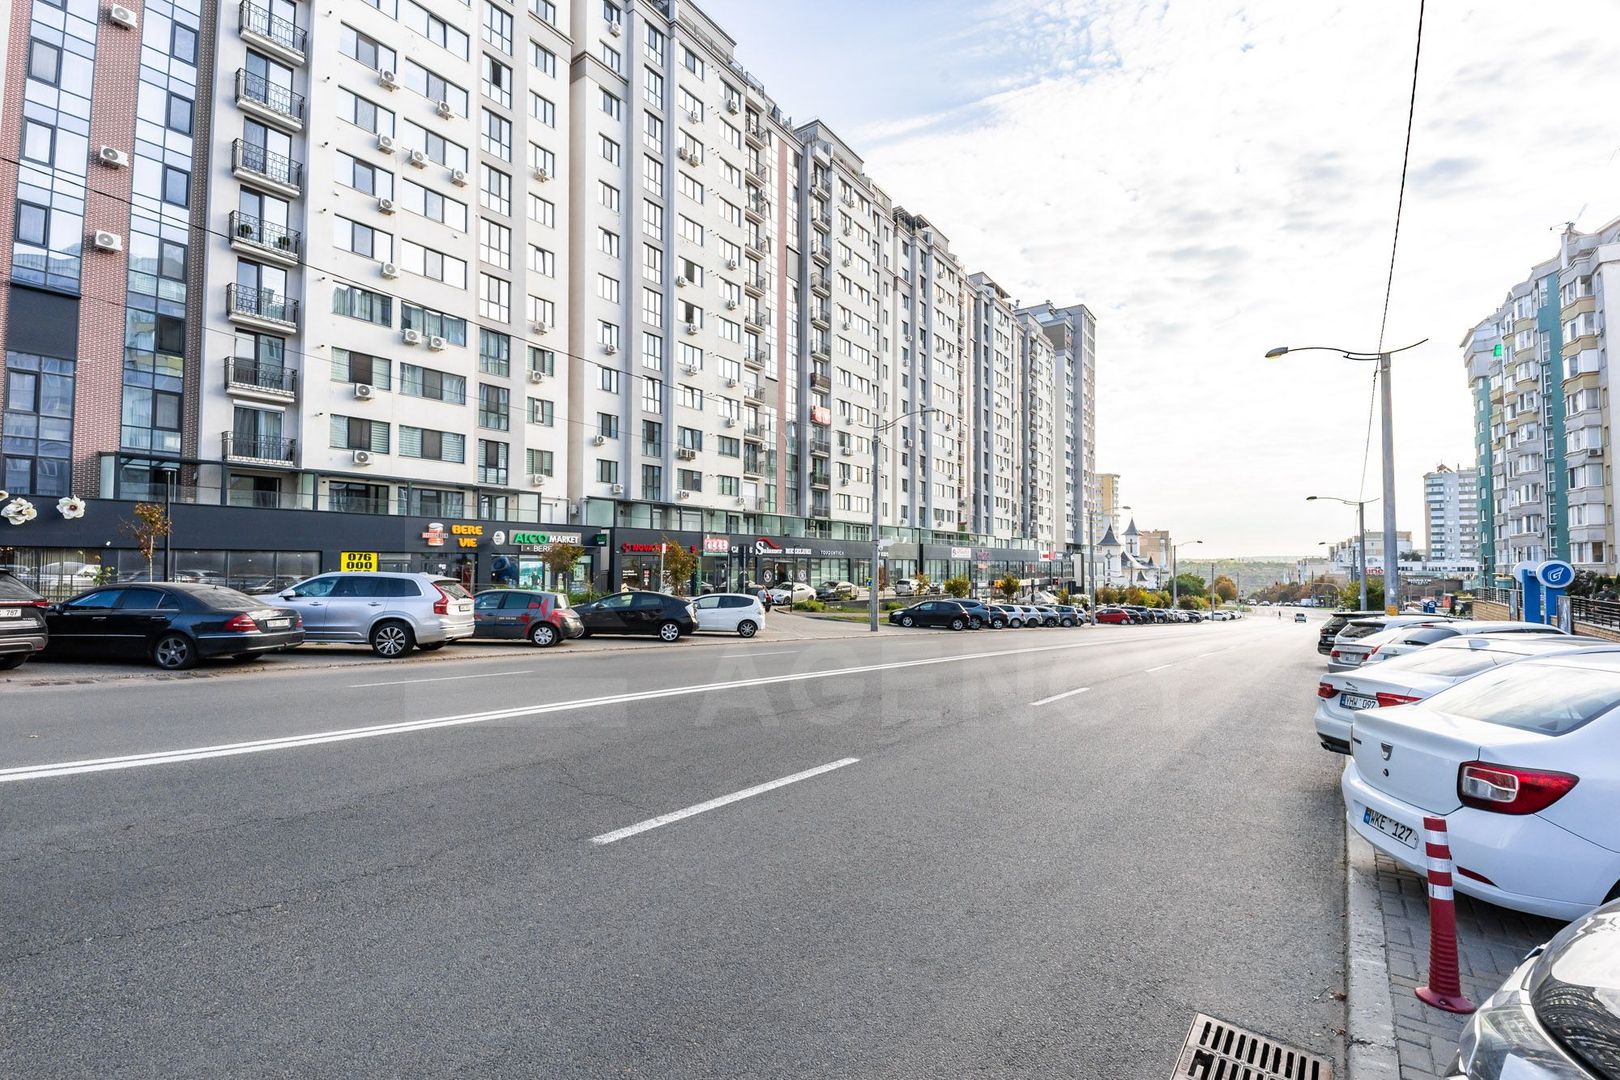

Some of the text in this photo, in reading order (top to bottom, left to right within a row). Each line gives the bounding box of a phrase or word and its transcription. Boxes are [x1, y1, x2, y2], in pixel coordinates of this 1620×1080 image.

[452, 524, 483, 536] BERE
[458, 538, 478, 548] VIE
[514, 533, 548, 544] ALCO
[549, 535, 578, 544] MARKET
[1346, 696, 1376, 710] YHW 097
[1392, 823, 1413, 842] 127
